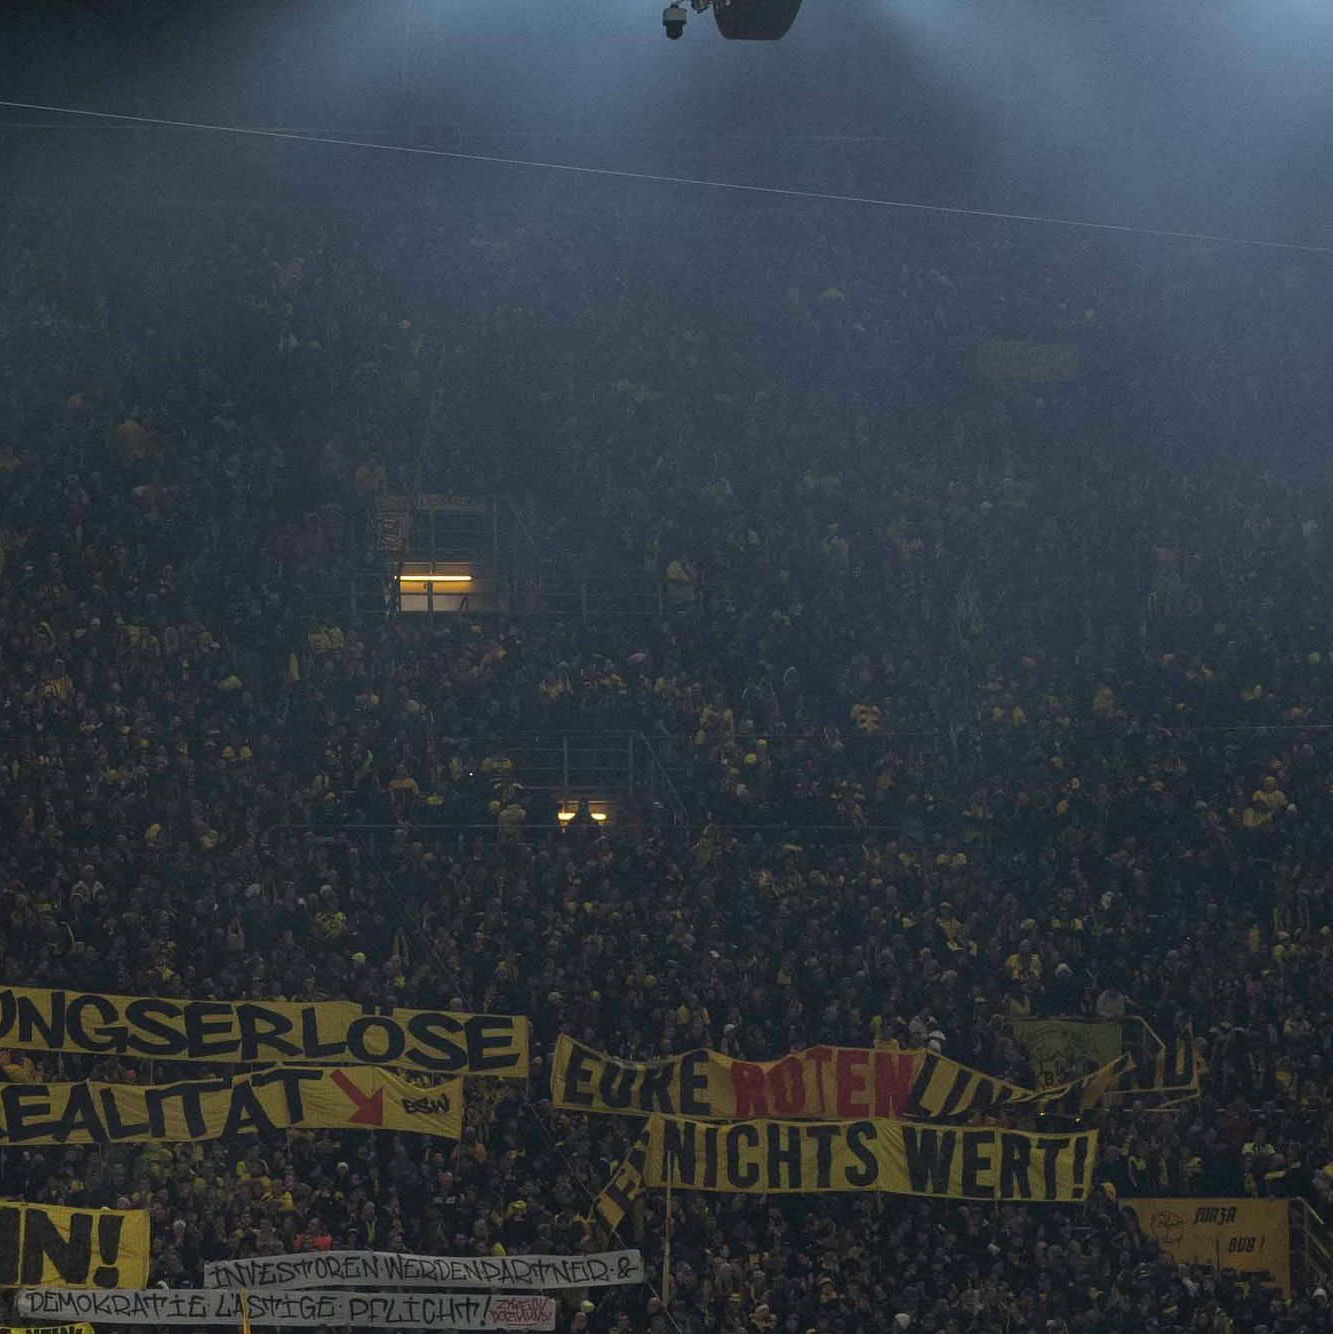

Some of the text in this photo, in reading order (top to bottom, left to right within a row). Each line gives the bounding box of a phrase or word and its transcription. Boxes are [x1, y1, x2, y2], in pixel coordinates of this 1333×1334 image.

[563, 1046, 711, 1115] EURE
[732, 1044, 915, 1119] ROTEN
[662, 1119, 879, 1188] NICHTS
[902, 1126, 1090, 1201] WERT!
[208, 1256, 380, 1289] INVESTOREN
[384, 1253, 482, 1283] WERDEN
[482, 1257, 610, 1284] PARTNER
[25, 1290, 208, 1319] DEMOKRATIE
[348, 1295, 490, 1327] PFLICHT!
